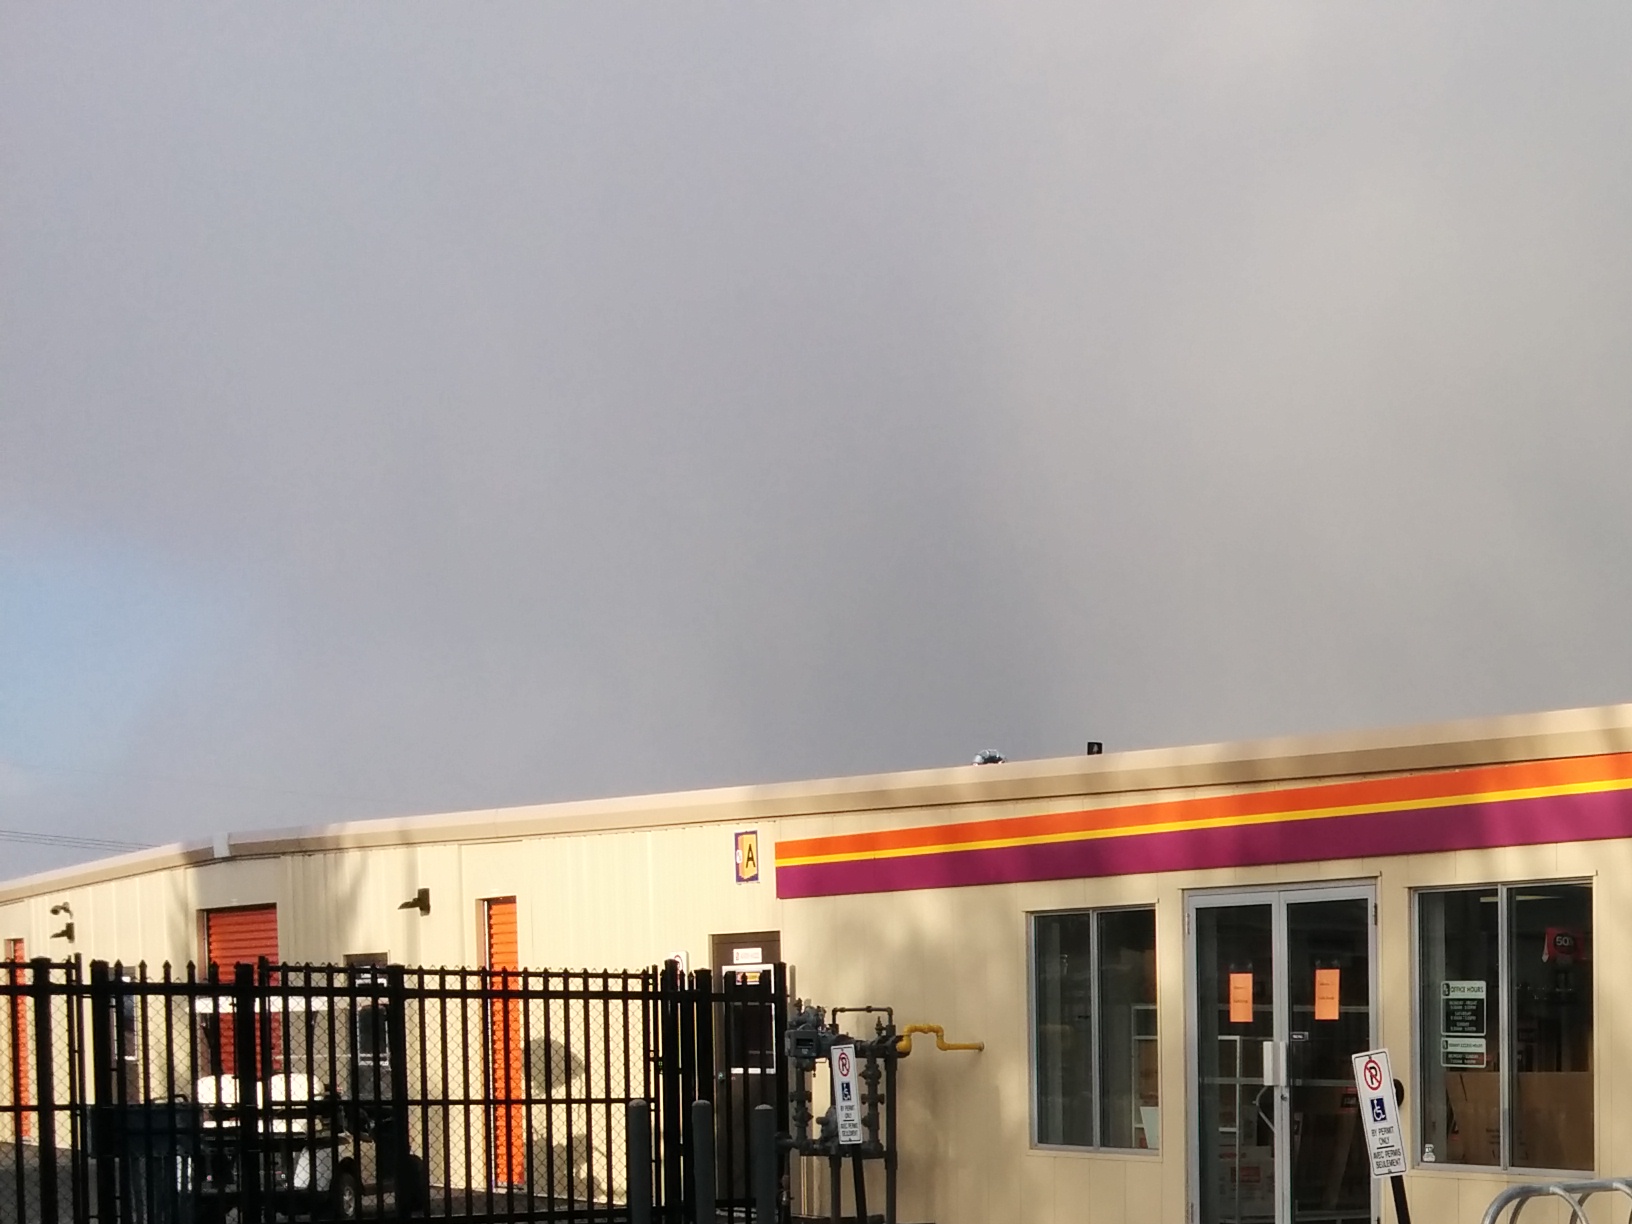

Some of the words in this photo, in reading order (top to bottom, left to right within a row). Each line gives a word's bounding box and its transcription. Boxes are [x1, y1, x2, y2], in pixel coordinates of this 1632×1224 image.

[745, 843, 756, 869] A
[1371, 1129, 1377, 1137] BY
[1378, 1126, 1394, 1136] PERMIT
[1378, 1136, 1390, 1145] ONLY
[1373, 1151, 1385, 1160] AVEC
[1385, 1148, 1401, 1159] PERMIS
[1375, 1158, 1401, 1169] SEULEMENT
